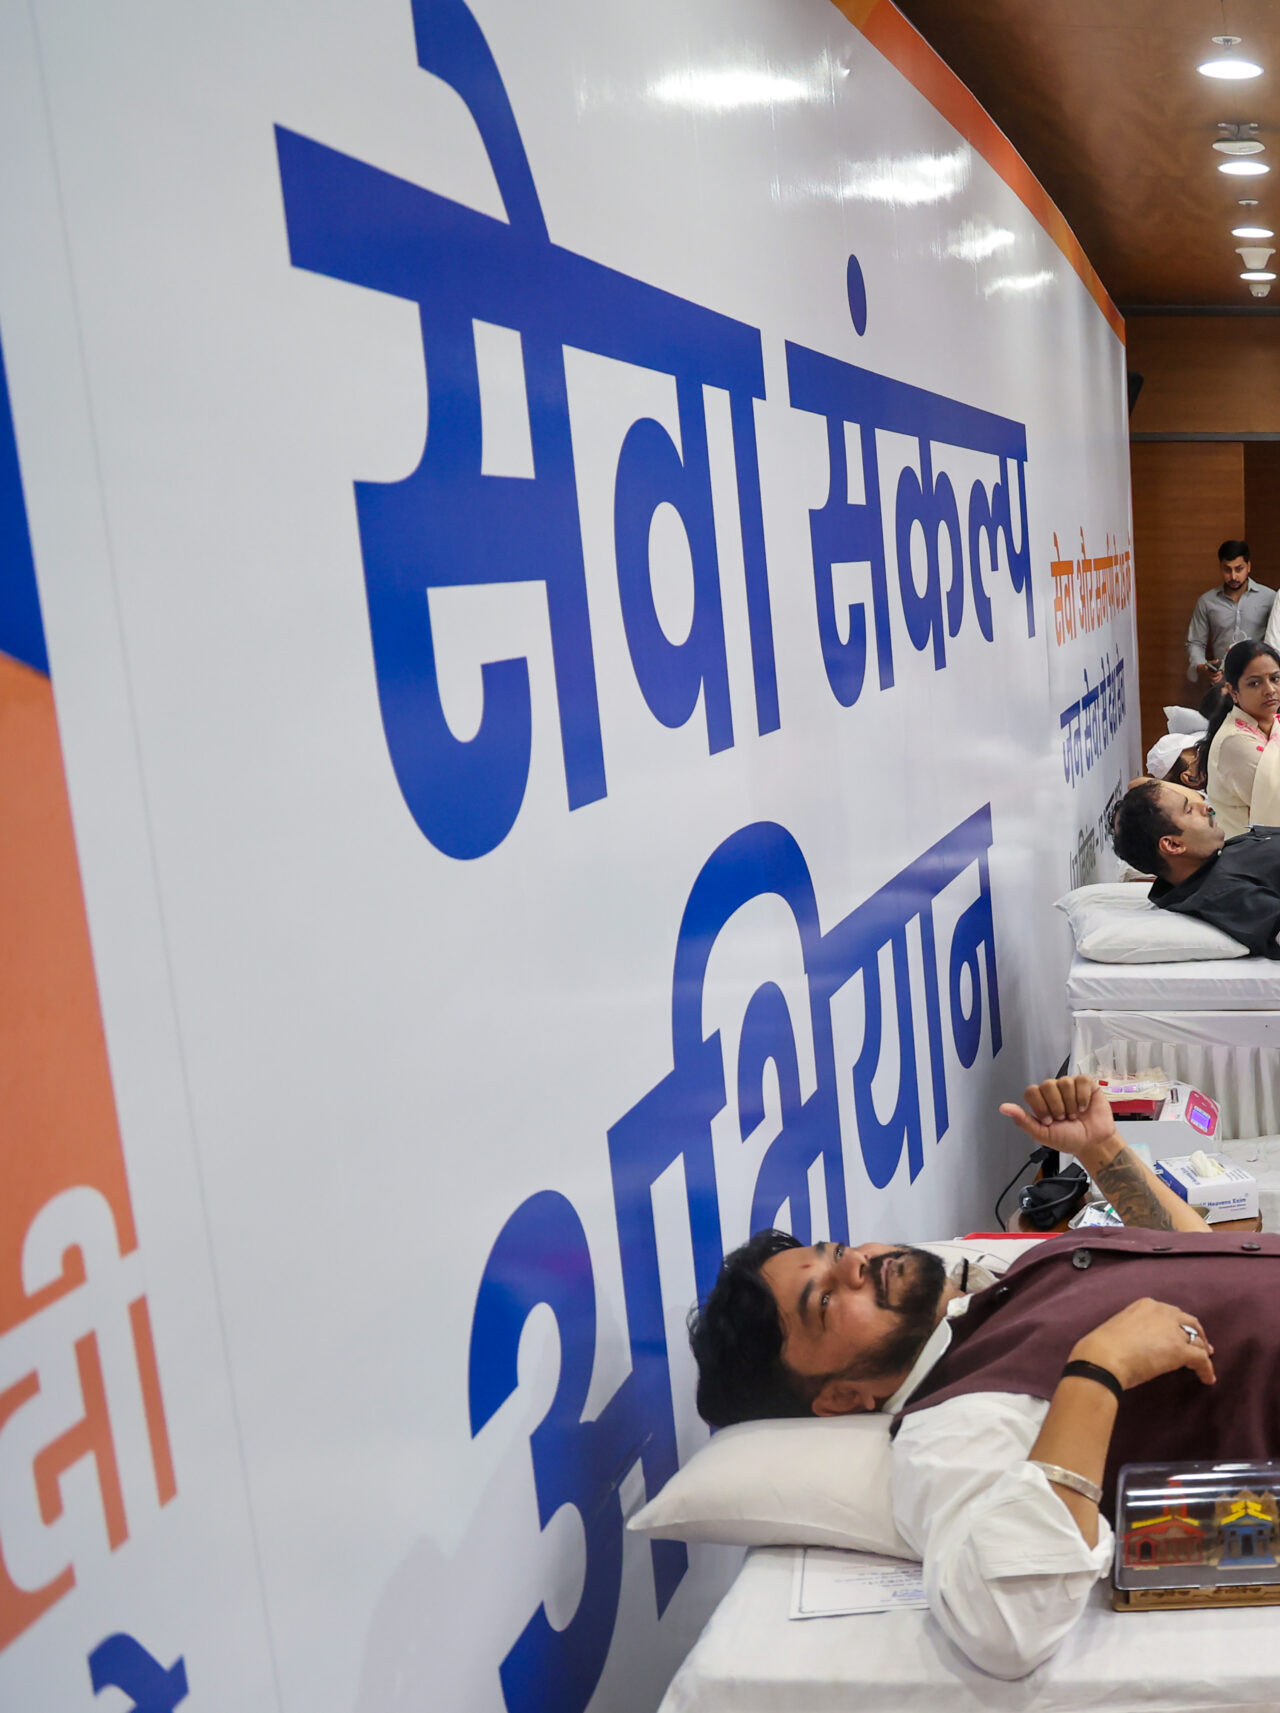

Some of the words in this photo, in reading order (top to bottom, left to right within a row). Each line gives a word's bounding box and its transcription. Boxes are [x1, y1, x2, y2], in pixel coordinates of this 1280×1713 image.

[274, 0, 781, 861] सेवा
[784, 254, 1038, 708] संकल्प
[1051, 532, 1077, 647] सेवा
[1077, 526, 1095, 633] और
[1060, 699, 1083, 789] जन
[1082, 667, 1102, 772] सेवा
[468, 802, 1003, 1713] अभियान
